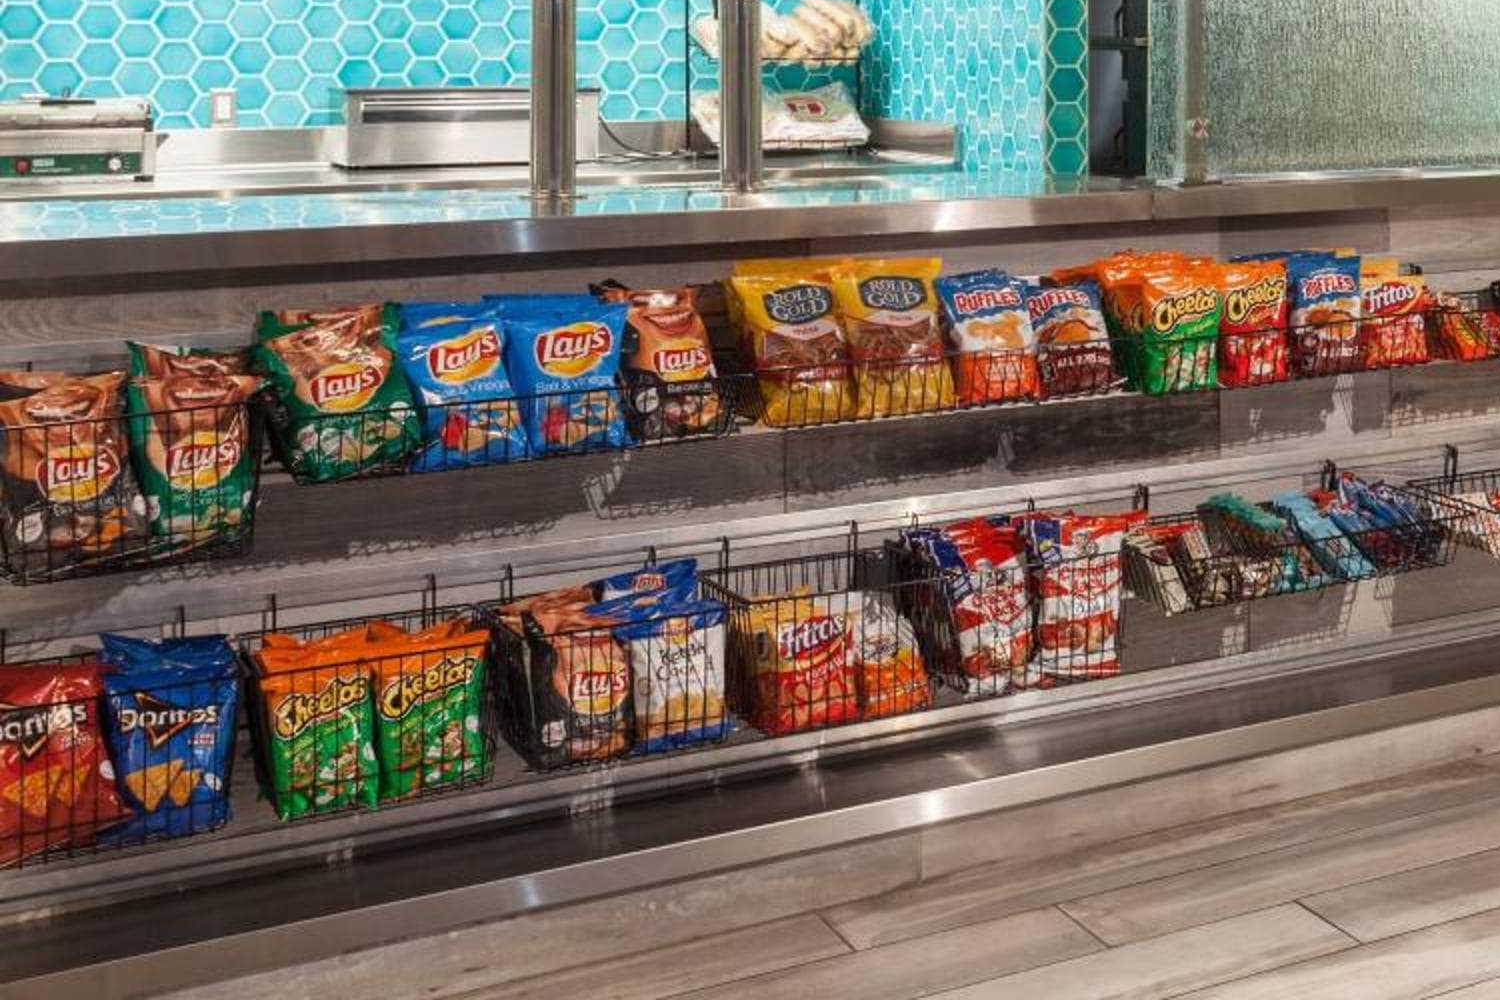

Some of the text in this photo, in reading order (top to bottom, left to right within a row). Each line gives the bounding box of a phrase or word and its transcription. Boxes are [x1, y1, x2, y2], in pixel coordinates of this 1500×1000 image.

[774, 287, 821, 304] ROLD
[867, 292, 921, 307] GOLD
[869, 280, 913, 293] ROLD
[955, 291, 1022, 312] RUFFLES
[1226, 278, 1285, 324] Cheetos
[1364, 284, 1415, 313] Fritos
[772, 299, 828, 320] GOLD
[1027, 289, 1089, 319] RUFFLES
[1152, 288, 1217, 333] Cheetos
[435, 335, 497, 373] Lay's
[542, 329, 606, 364] Lay's
[659, 346, 707, 374] Lay's
[318, 368, 376, 403] Lay's
[48, 453, 112, 489] Lay's
[170, 439, 239, 478] Lay's
[384, 658, 475, 720] Cheetos
[573, 666, 629, 698] Lay's
[120, 704, 219, 733] Doritos
[276, 678, 368, 740] Cheetos
